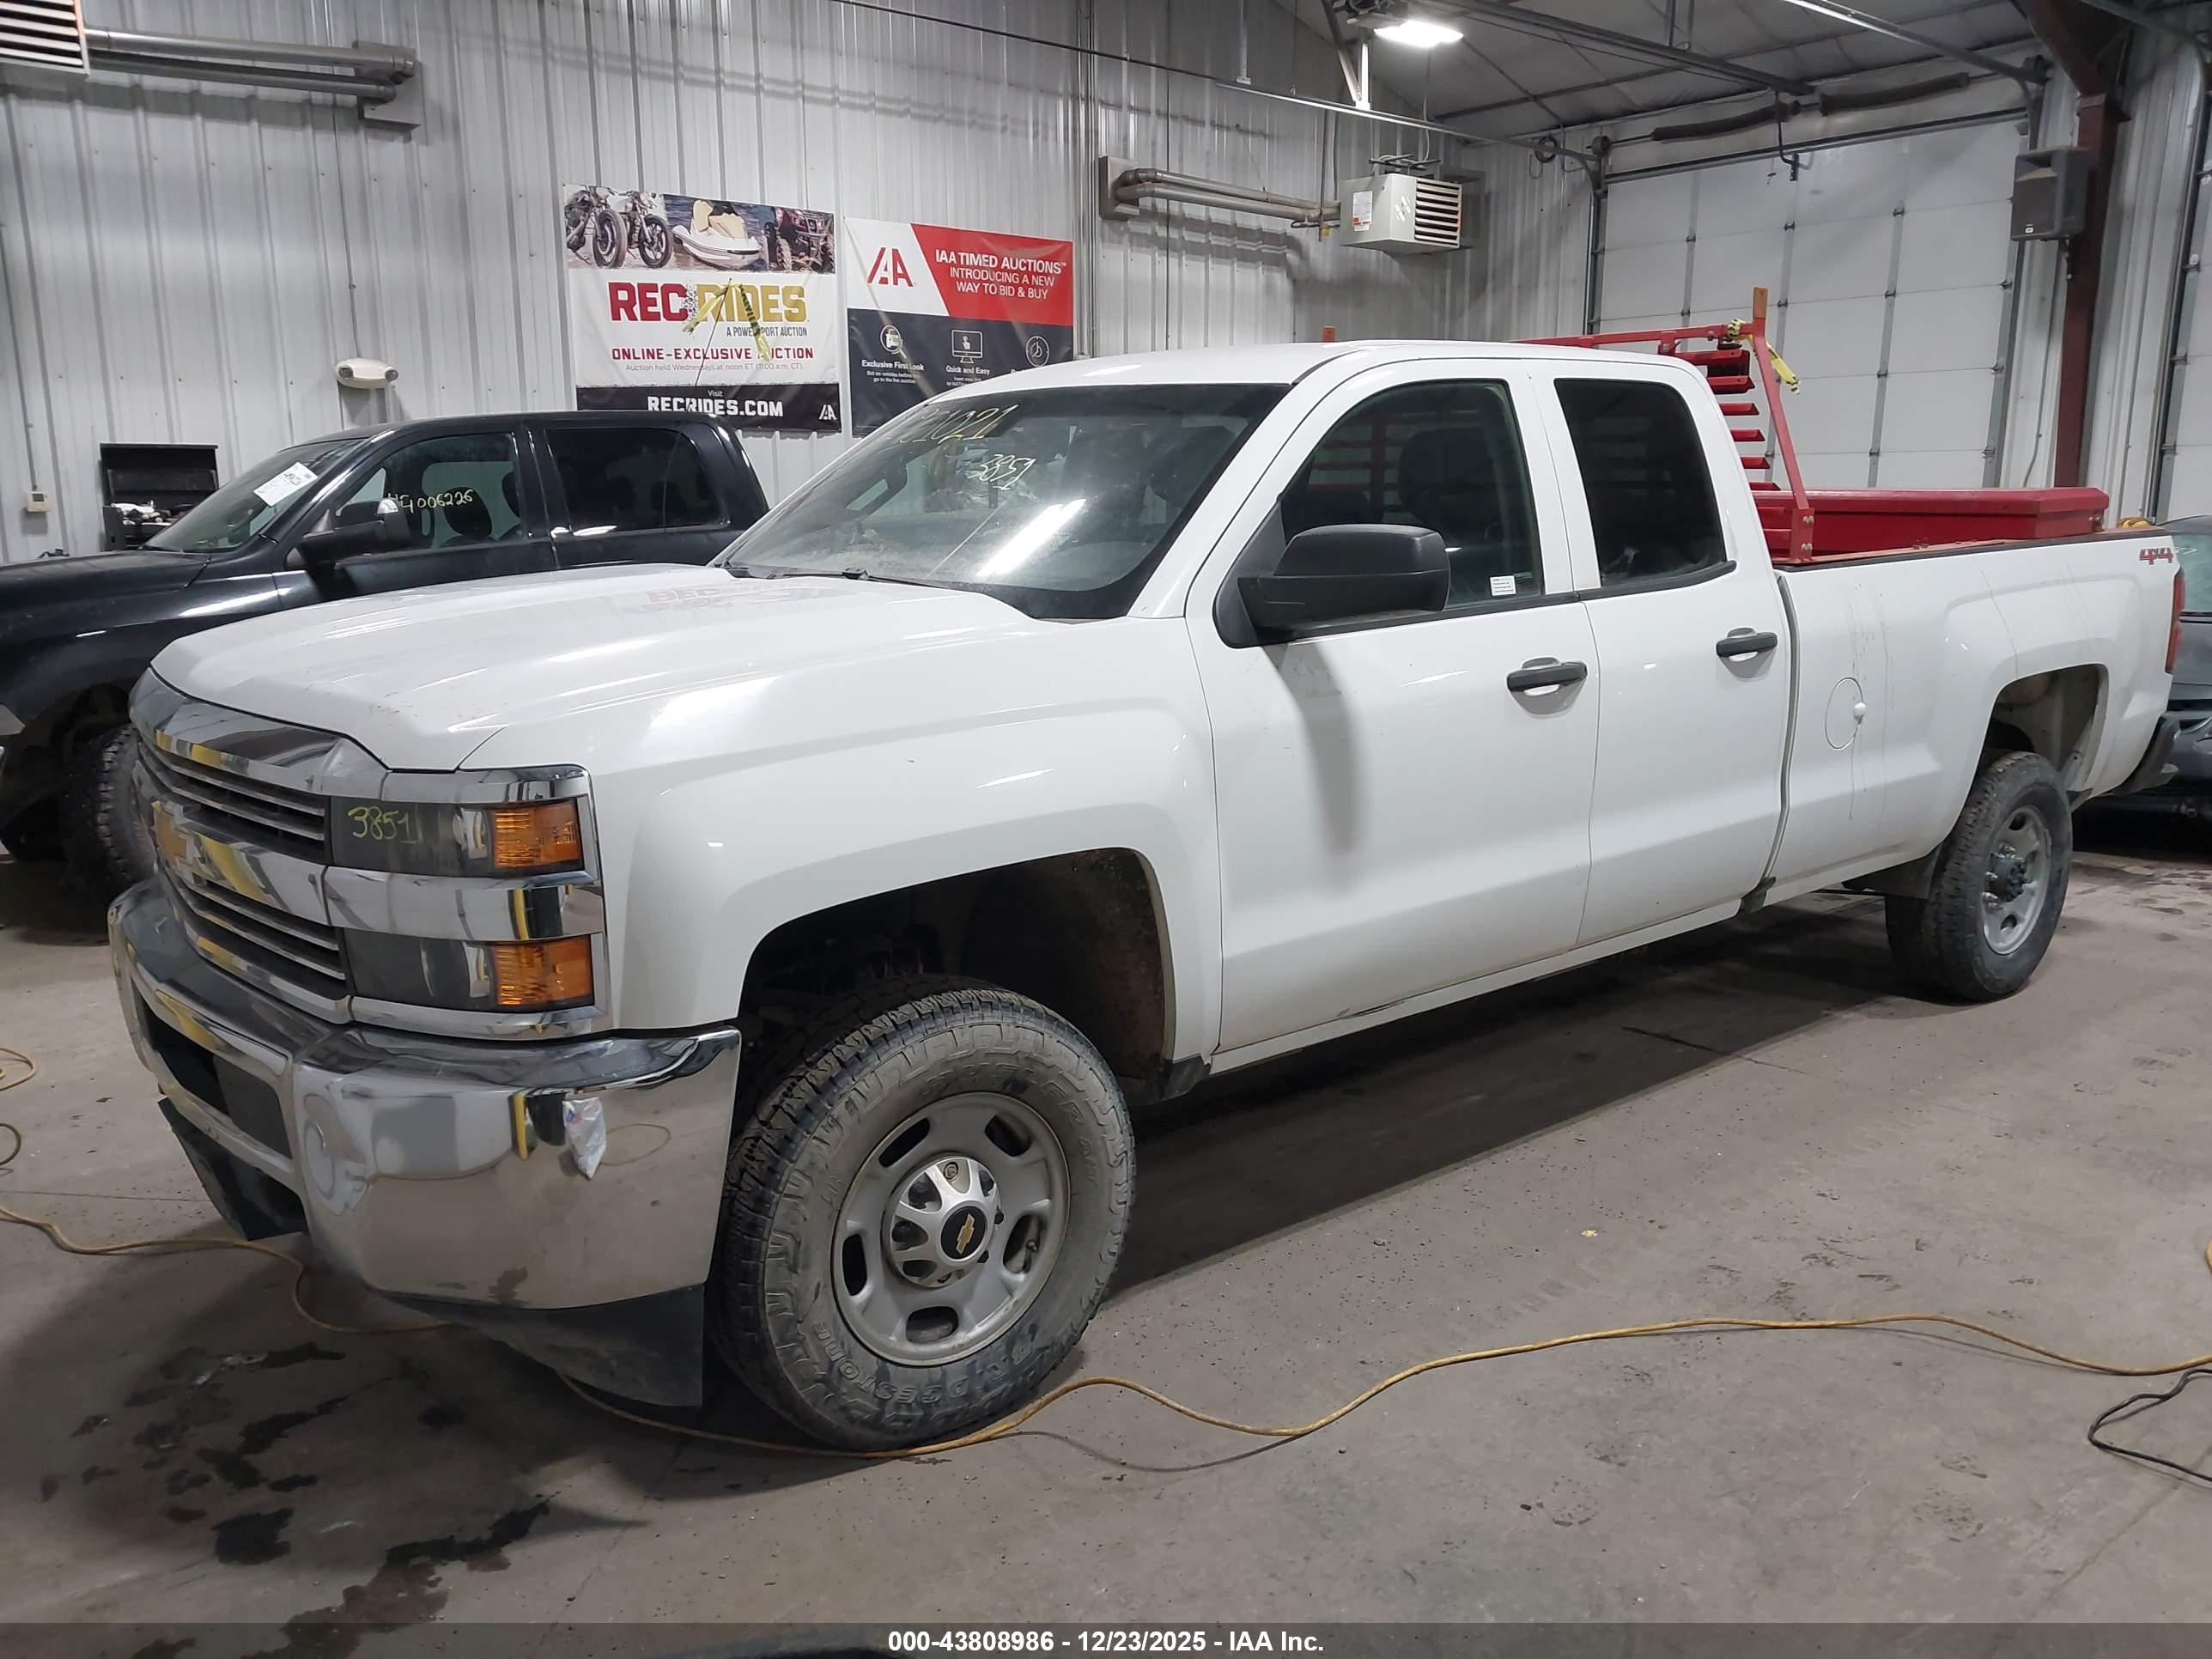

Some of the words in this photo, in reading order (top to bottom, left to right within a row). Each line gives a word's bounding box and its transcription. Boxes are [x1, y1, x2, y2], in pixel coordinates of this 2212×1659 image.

[935, 249, 957, 265] IAA
[957, 252, 999, 269] TIMED
[950, 266, 1019, 284] INTRODUCING
[1022, 274, 1030, 285] A
[1031, 275, 1054, 287] NEW
[956, 280, 980, 294] WAY
[982, 283, 998, 295] TO
[1000, 285, 1016, 297] BID
[1018, 286, 1025, 298] &
[1027, 287, 1048, 300] BUY
[726, 327, 732, 337] A
[733, 326, 779, 337] POWEPORT
[780, 326, 807, 337] AUCTION
[611, 348, 752, 360] ONLINE-EXCLUSIVE
[757, 347, 814, 360] CTION
[861, 359, 893, 368] Exclusive
[894, 361, 909, 370] First
[945, 365, 962, 374] Quick
[975, 367, 990, 375] Easy
[708, 389, 724, 398] Visit
[647, 396, 784, 417] RECRIDES.COM
[966, 453, 1037, 490] 3851
[347, 805, 418, 844] 3851
